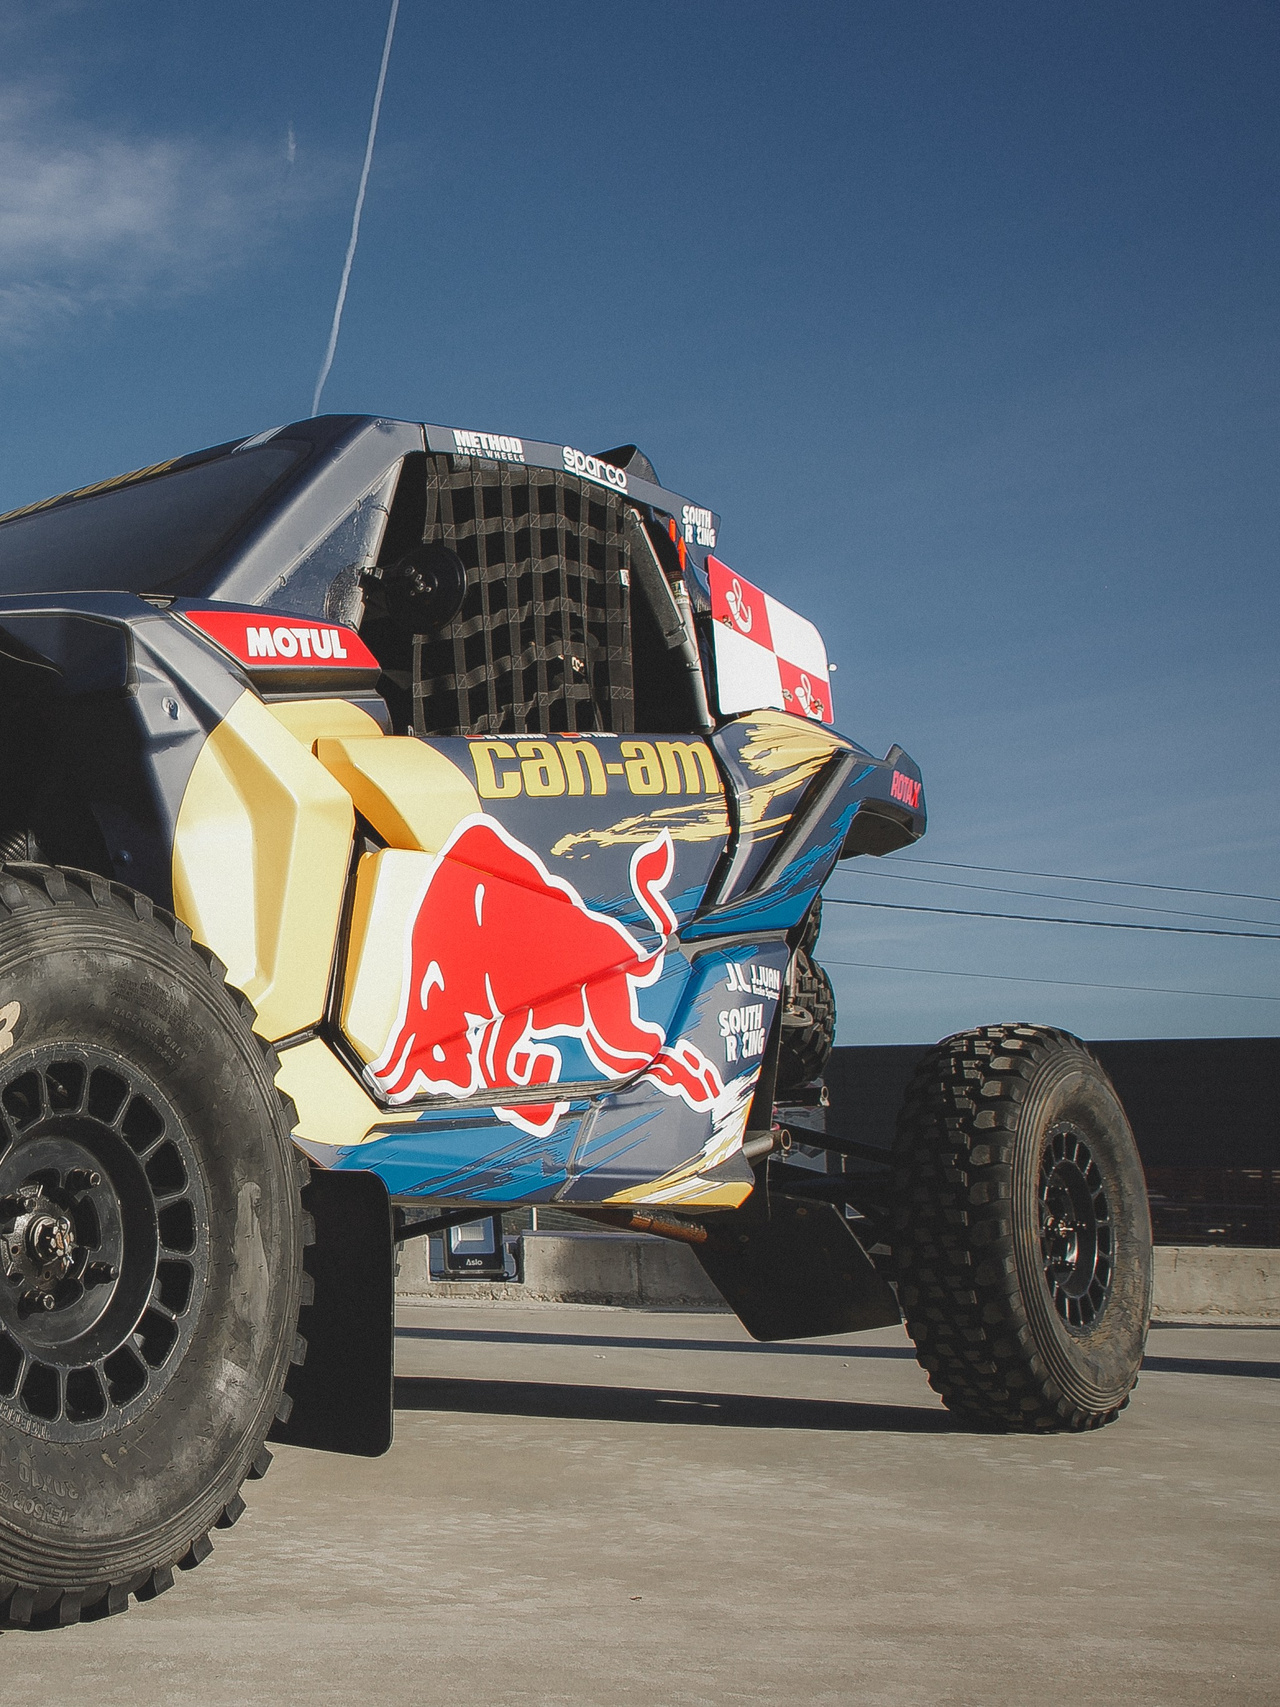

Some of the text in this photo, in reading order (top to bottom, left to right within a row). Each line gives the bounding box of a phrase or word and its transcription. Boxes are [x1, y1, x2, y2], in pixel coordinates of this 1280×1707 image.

[453, 430, 523, 454] METHOD
[457, 446, 525, 463] RACE WHEELS
[562, 446, 627, 490] sparco
[682, 505, 712, 529] SOUTH
[246, 627, 347, 659] MOTUL
[890, 770, 922, 808] ROTAX
[113, 1006, 139, 1023] RACE
[143, 1020, 162, 1036] USE
[164, 1036, 188, 1059] ONLY
[719, 1003, 763, 1037] SOUTH
